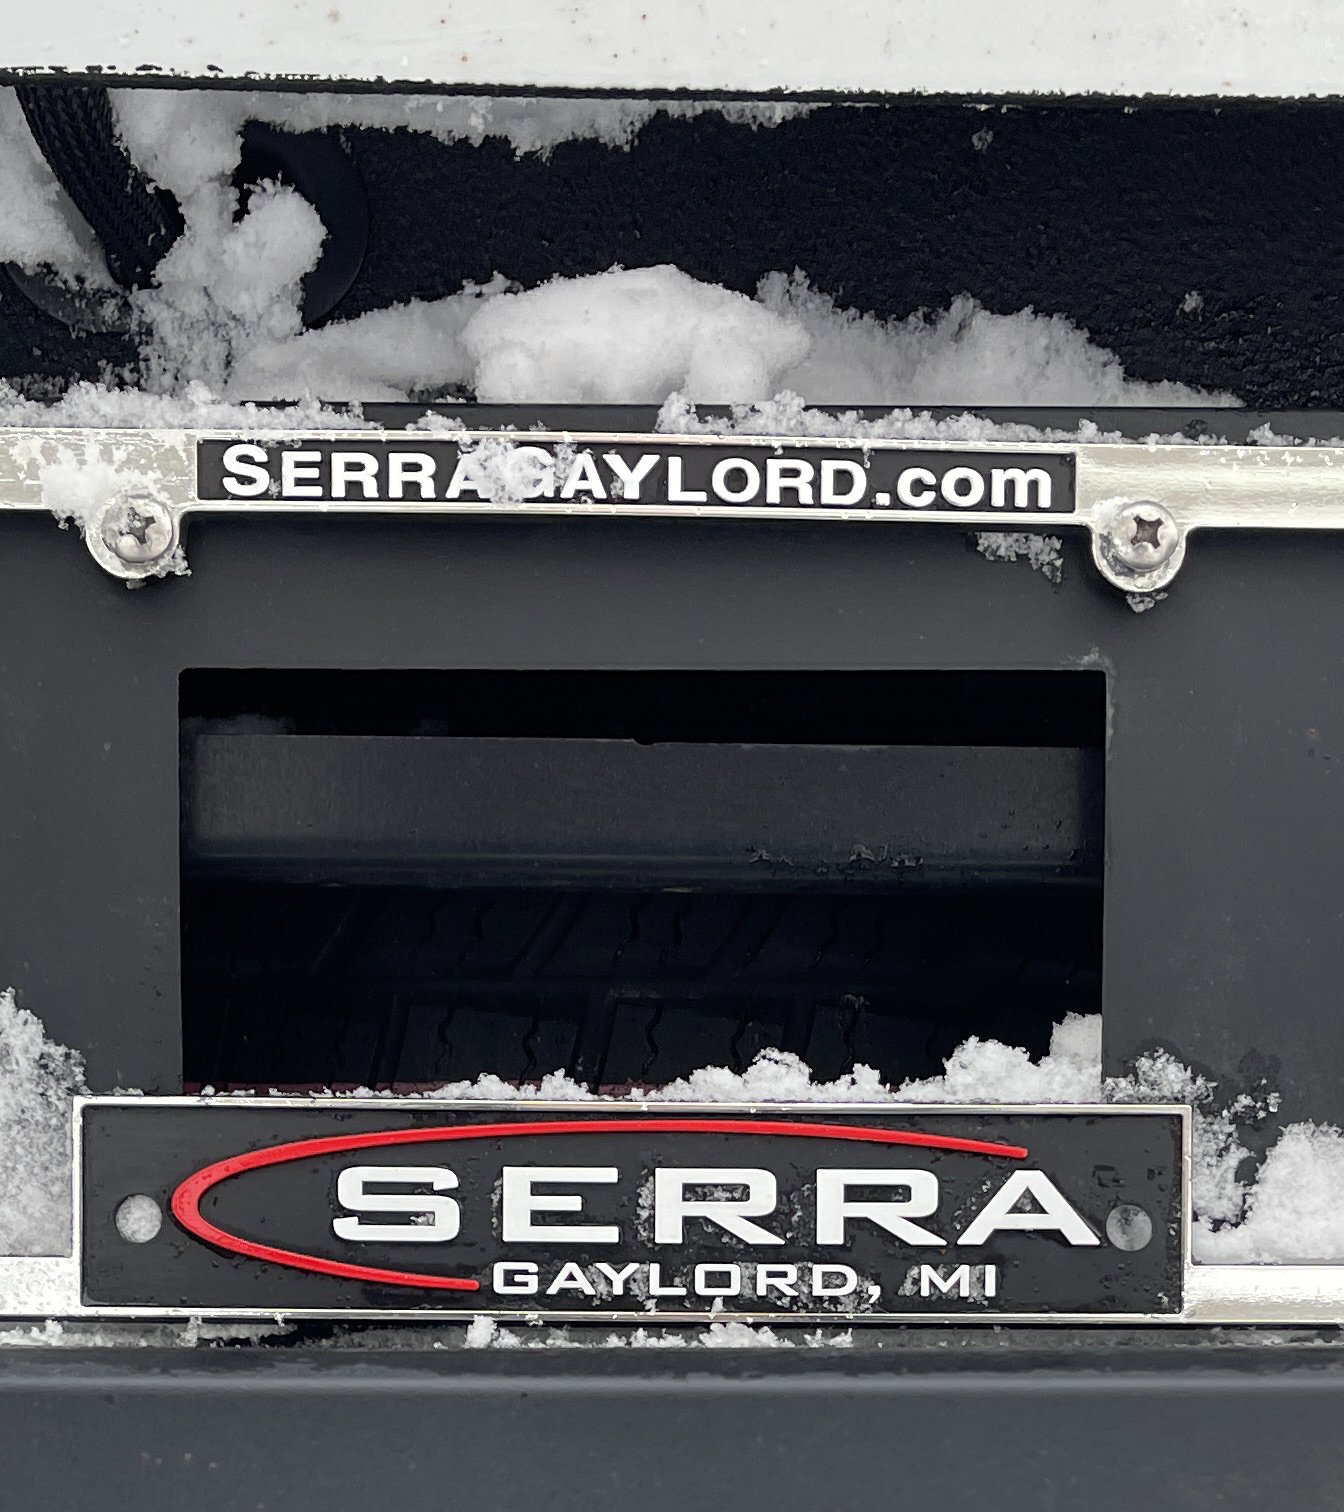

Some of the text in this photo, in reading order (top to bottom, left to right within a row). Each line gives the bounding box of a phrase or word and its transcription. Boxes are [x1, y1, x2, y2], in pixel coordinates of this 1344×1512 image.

[333, 1166, 1101, 1247] SERRA
[492, 1261, 997, 1304] GAYLORD, MI
